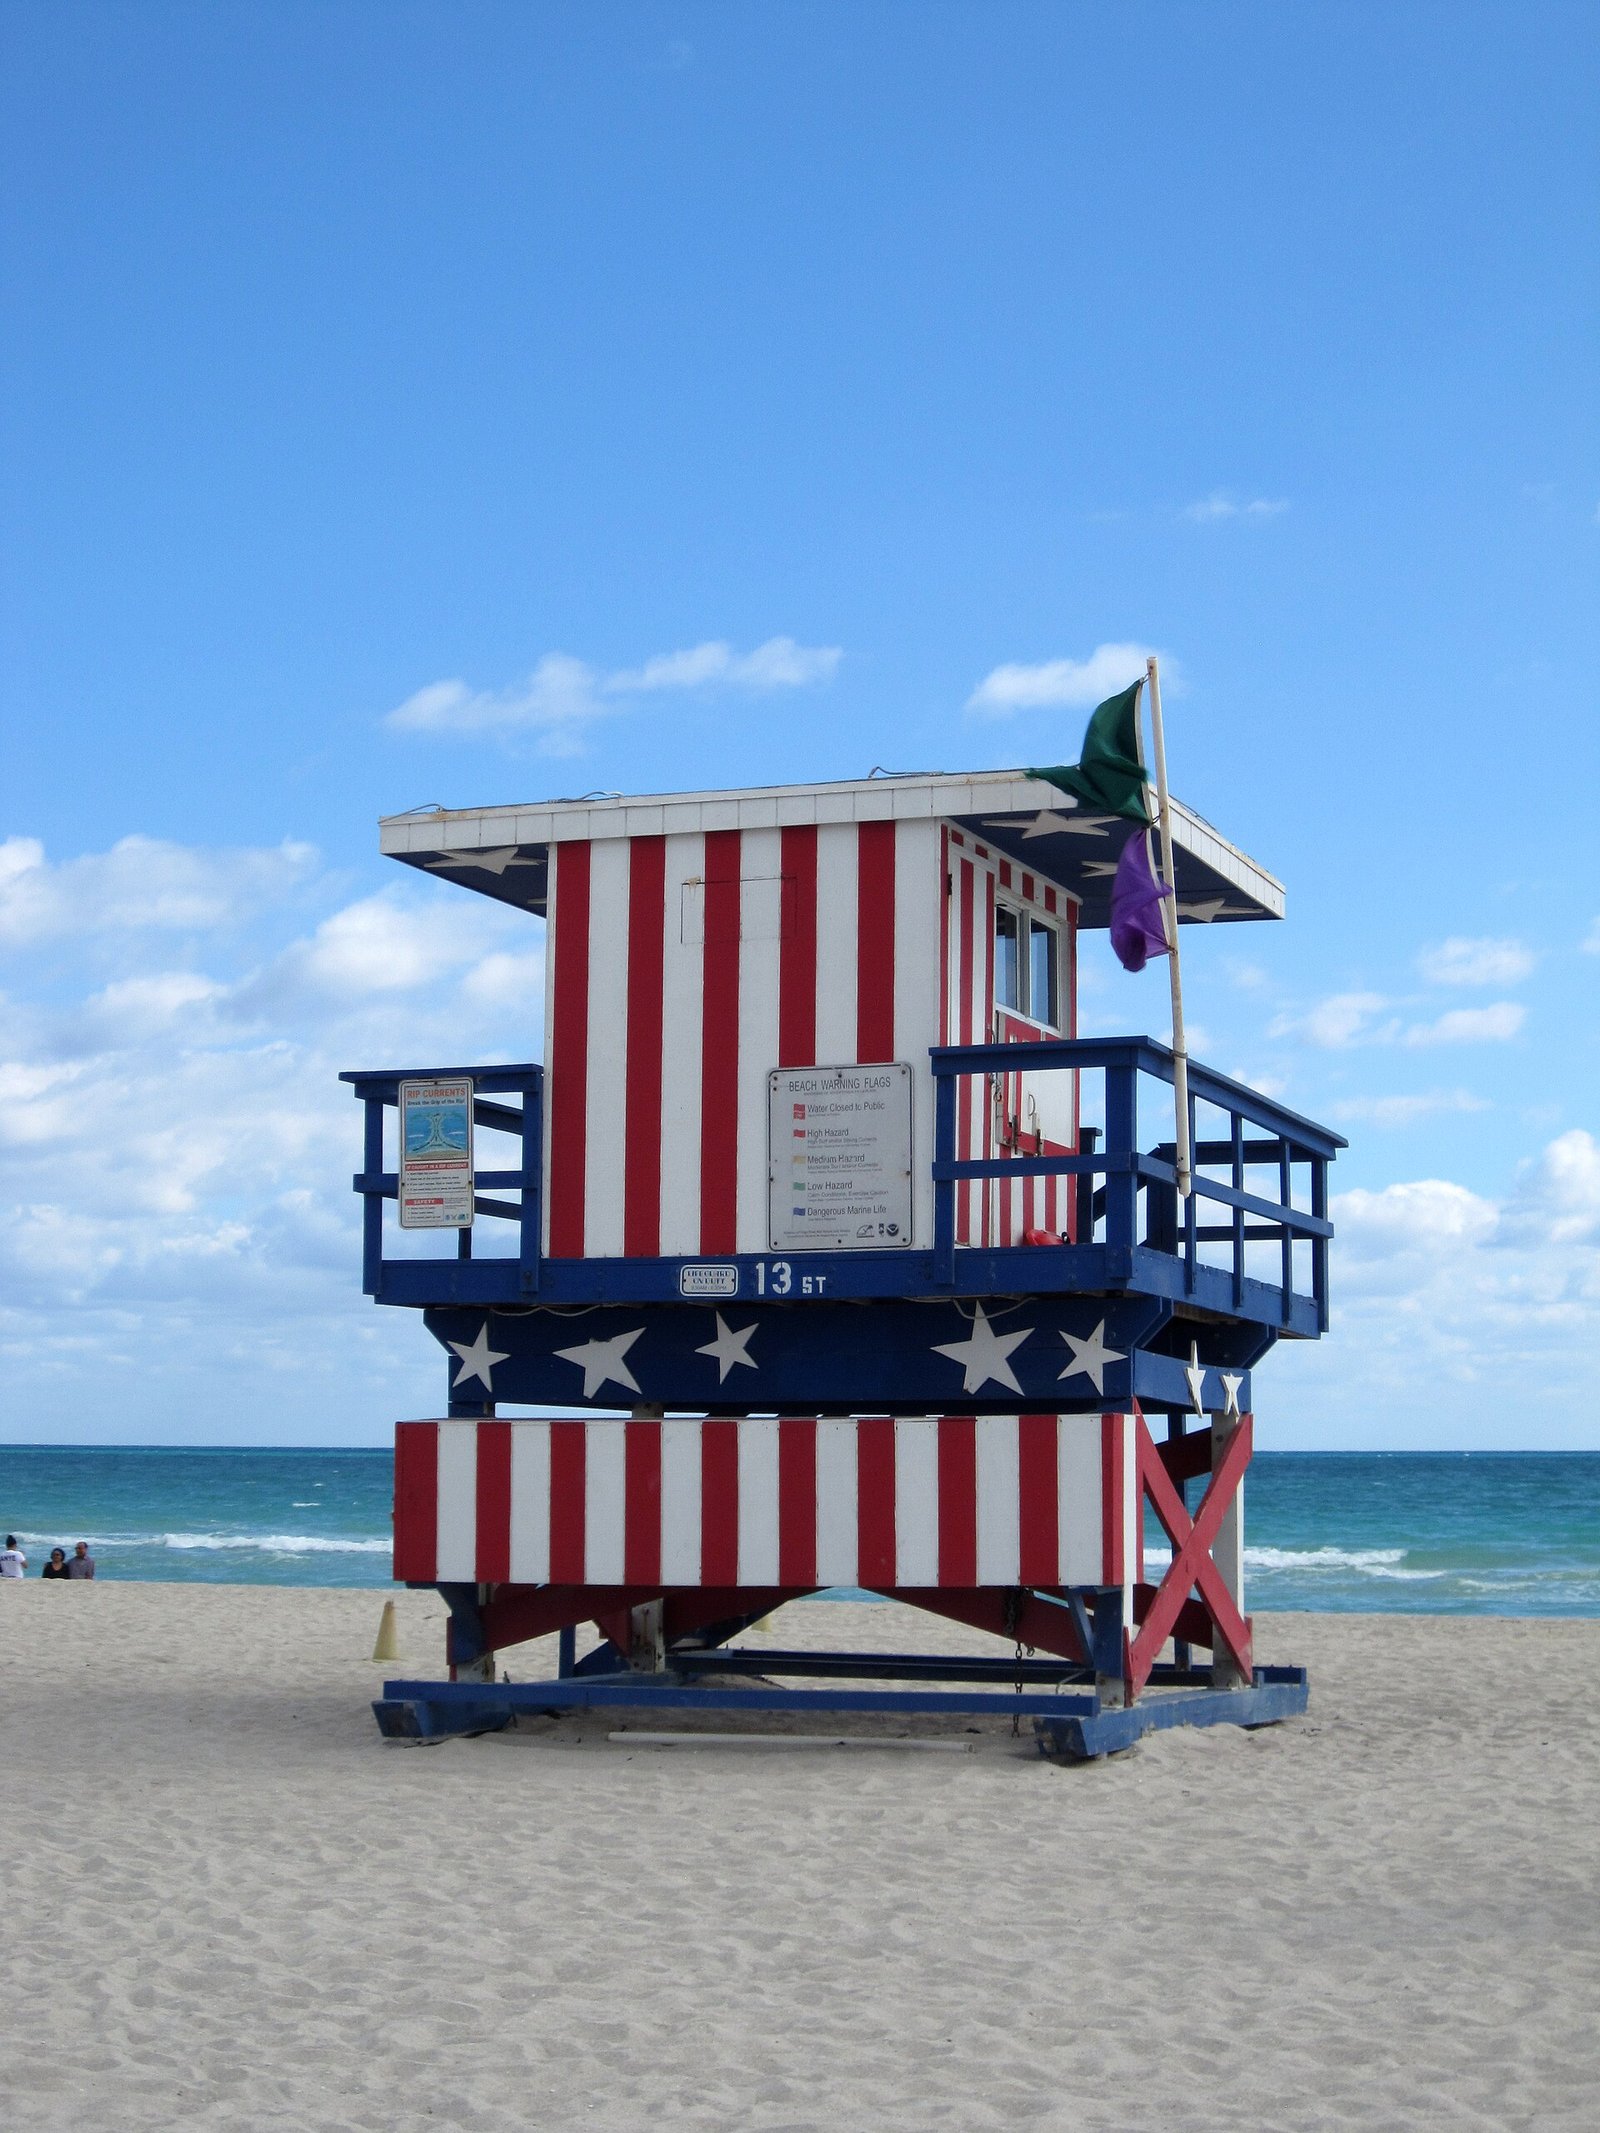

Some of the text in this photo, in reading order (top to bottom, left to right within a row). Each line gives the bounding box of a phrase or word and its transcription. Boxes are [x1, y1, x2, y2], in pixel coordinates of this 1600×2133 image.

[789, 1076, 891, 1092] BEACH WARNING FLAGS
[407, 1088, 465, 1098] RIP CURRENTS
[807, 1101, 885, 1113] Water Closed to Public
[807, 1128, 849, 1139] High Hazard
[807, 1154, 865, 1164] Medium Hazard
[807, 1181, 853, 1191] Low Hazard
[807, 1204, 887, 1217] Dangerous Marine Life
[755, 1261, 827, 1295] 13 ST
